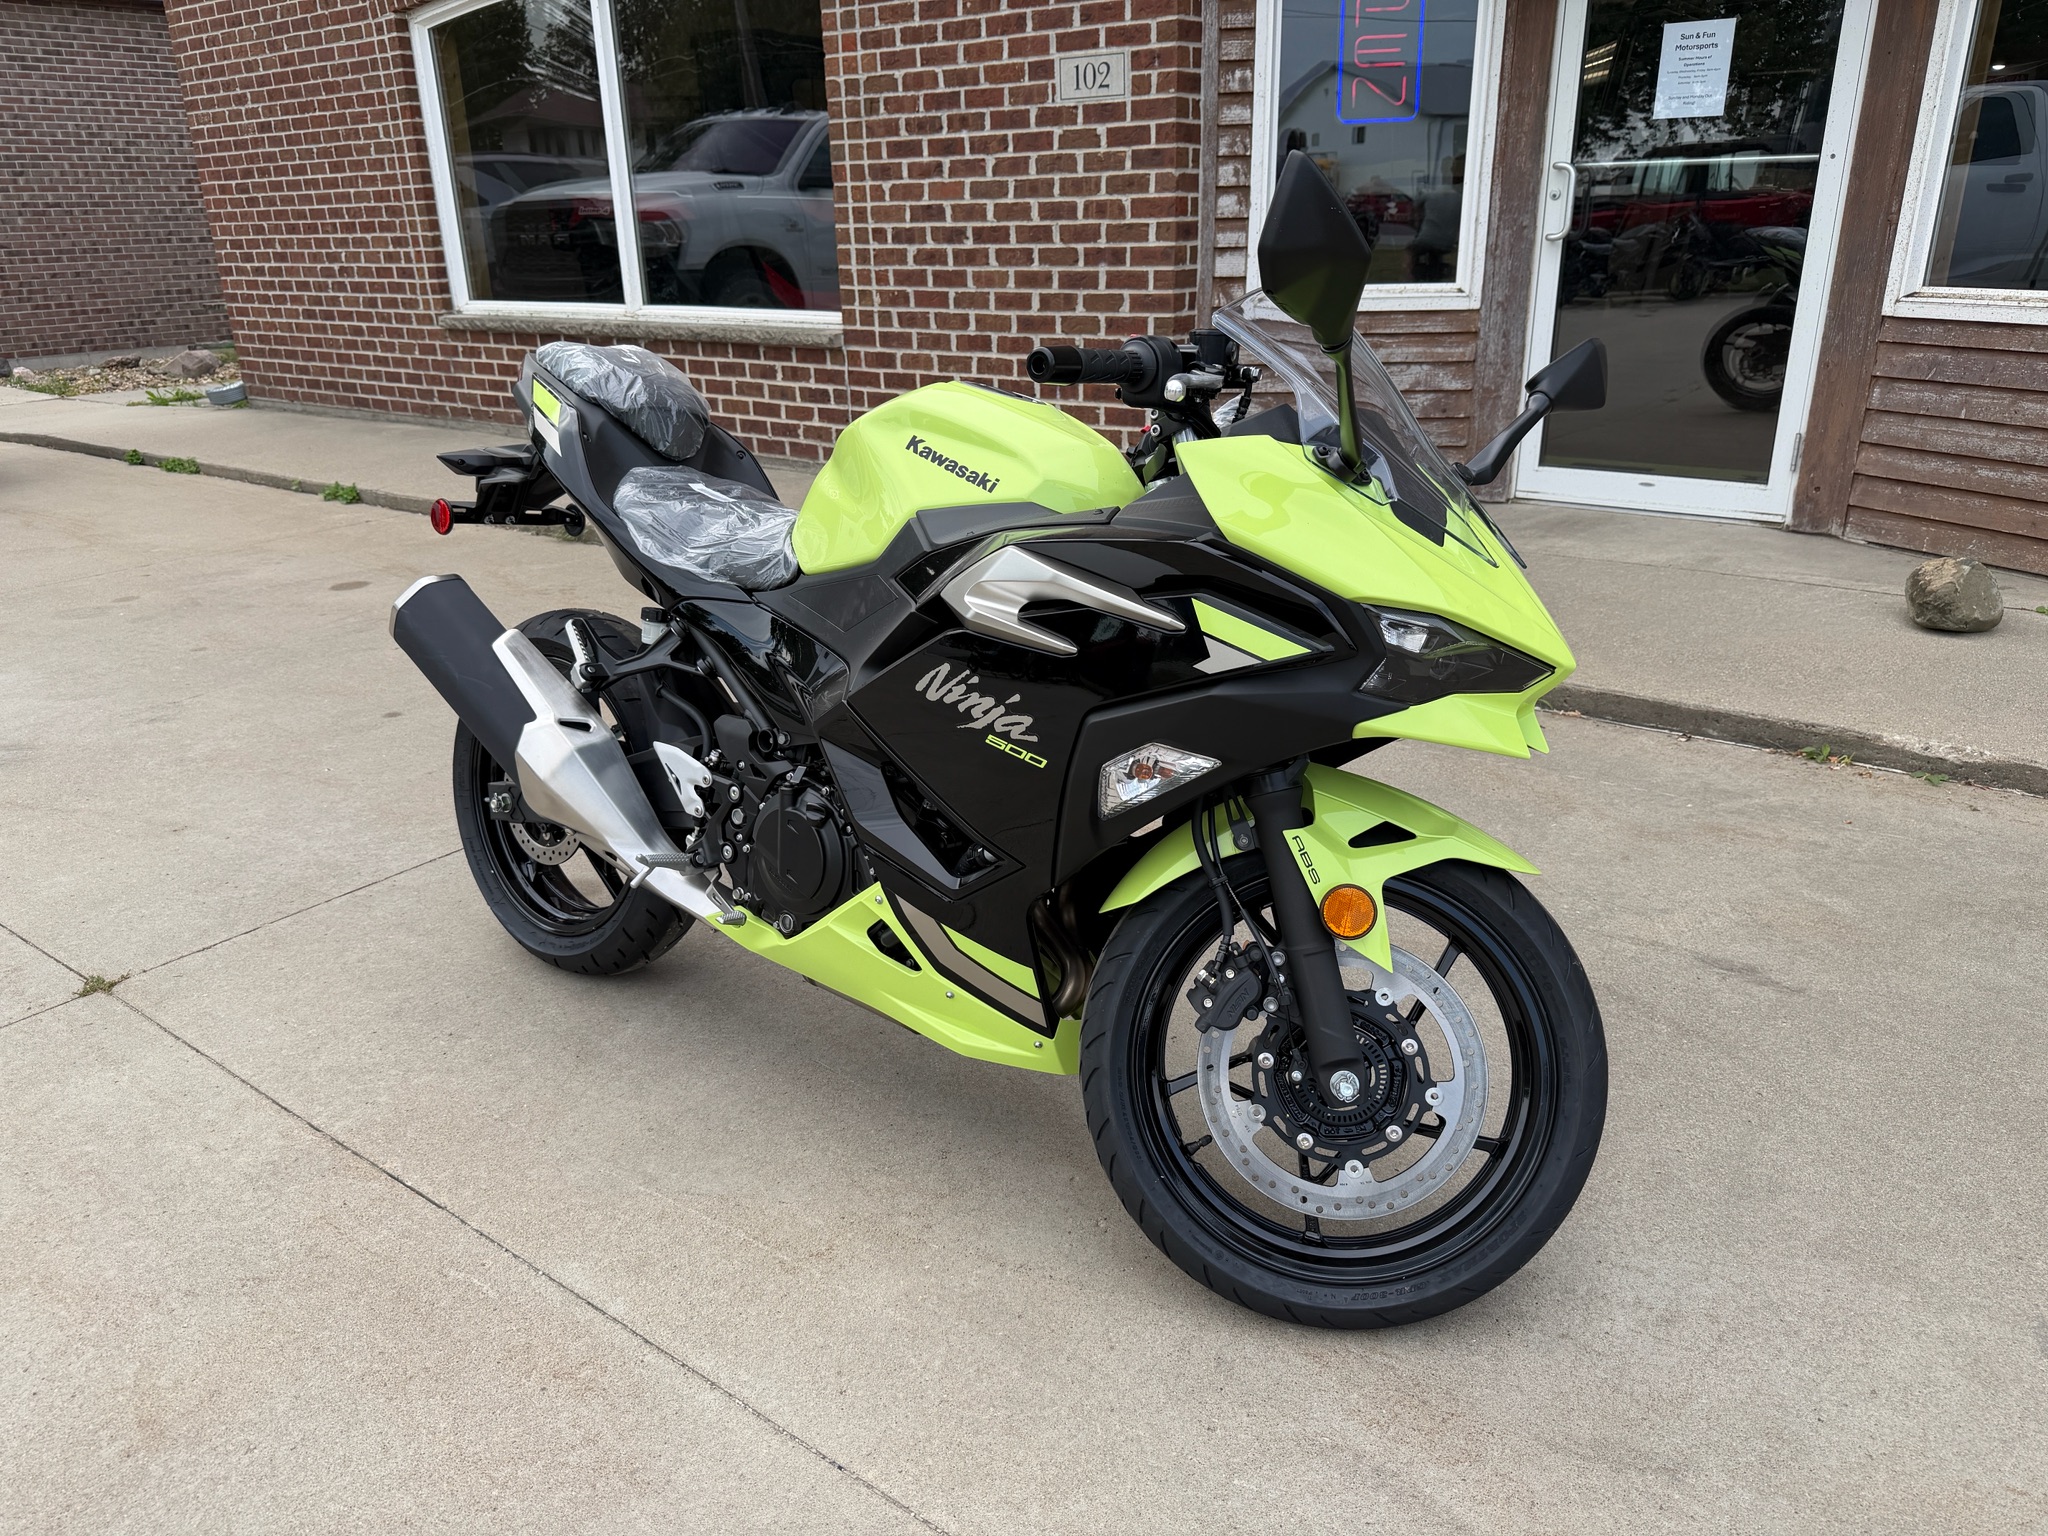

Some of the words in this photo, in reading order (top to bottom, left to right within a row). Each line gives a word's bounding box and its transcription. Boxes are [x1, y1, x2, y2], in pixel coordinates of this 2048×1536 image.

[1352, 0, 1410, 108] PEN
[1675, 42, 1719, 51] Motorsports
[1074, 61, 1111, 91] 102
[905, 435, 1000, 493] Kawasaki
[915, 662, 1038, 742] Ninja
[985, 734, 1047, 768] 500
[1292, 835, 1320, 884] ABS
